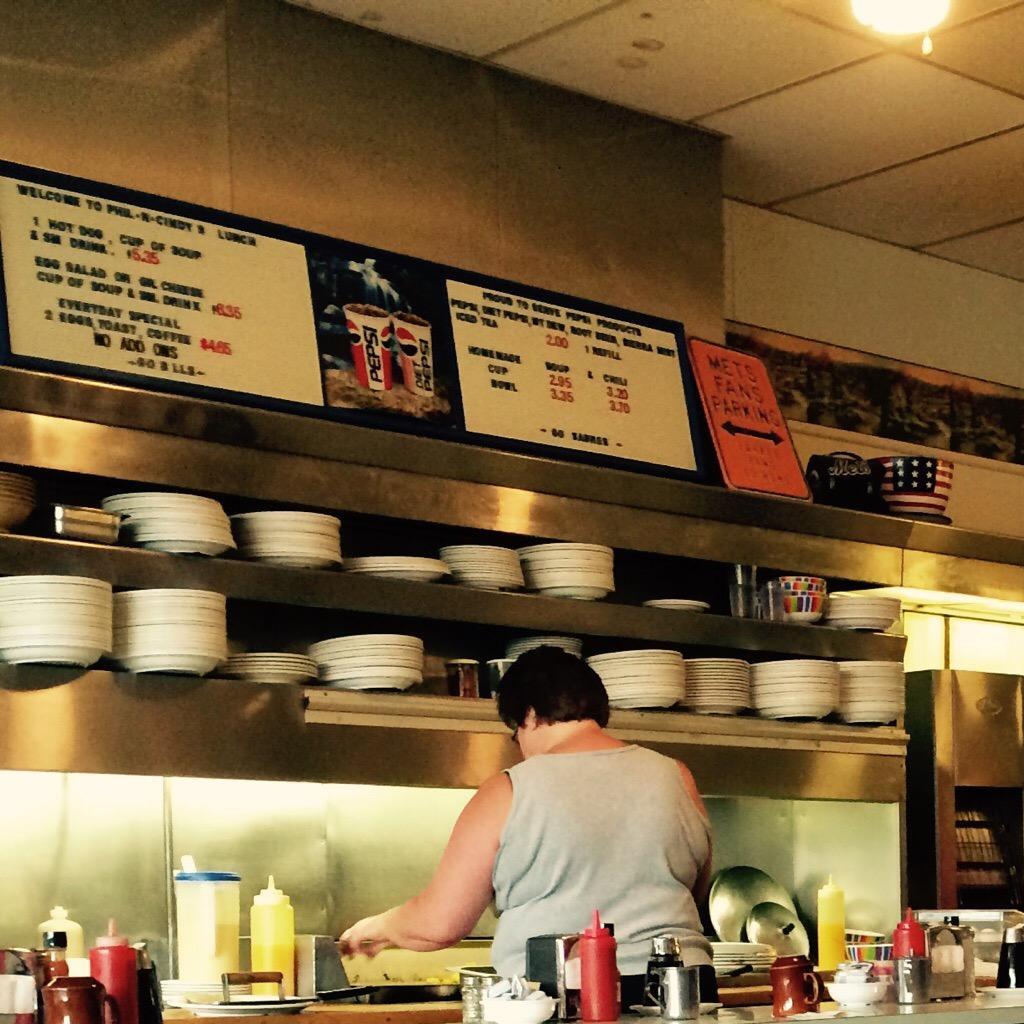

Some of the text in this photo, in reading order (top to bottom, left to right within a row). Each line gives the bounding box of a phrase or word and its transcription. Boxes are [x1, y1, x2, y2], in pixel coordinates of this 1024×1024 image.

[16, 184, 80, 207] WELCOME
[86, 199, 102, 211] TO
[217, 229, 256, 246] LUNCH
[30, 230, 38, 240] &
[48, 219, 73, 233] HOT
[120, 234, 144, 247] CUP
[151, 241, 165, 252] OF
[171, 245, 202, 260] SOUP
[34, 255, 60, 269] EGG
[65, 261, 106, 279] SALAD
[114, 271, 131, 284] OR
[161, 281, 205, 299] CHEESE
[36, 271, 63, 284] CUP
[67, 277, 83, 288] OF
[91, 281, 122, 296] SOUP
[127, 287, 136, 299] &
[163, 295, 201, 312] DRINK
[44, 309, 53, 321] 2
[147, 328, 191, 346] COFFEE
[57, 298, 181, 330] EVERYDAY SPECIAL
[456, 313, 498, 329] ICED TEA
[483, 292, 642, 337] PROUD TO SERVE PEPSI PRODUCTS
[94, 332, 111, 348] NO
[120, 336, 146, 354] ADD
[482, 306, 501, 318] DIET
[570, 326, 592, 338] ROOT
[623, 337, 654, 352] SIERRA
[657, 346, 675, 359] MIST
[545, 335, 569, 349] 2.00
[593, 346, 622, 361] REFILL
[362, 325, 383, 383] PEPSI
[418, 338, 433, 392] PEPSI
[488, 364, 508, 376] CUP
[706, 354, 757, 384] METS
[491, 379, 518, 393] BOWL
[545, 361, 570, 374] SOUP
[587, 370, 594, 380] &
[603, 374, 628, 387] CHILI
[713, 375, 763, 404] FANS
[710, 394, 781, 428] PARKING
[827, 459, 872, 476] Mets
